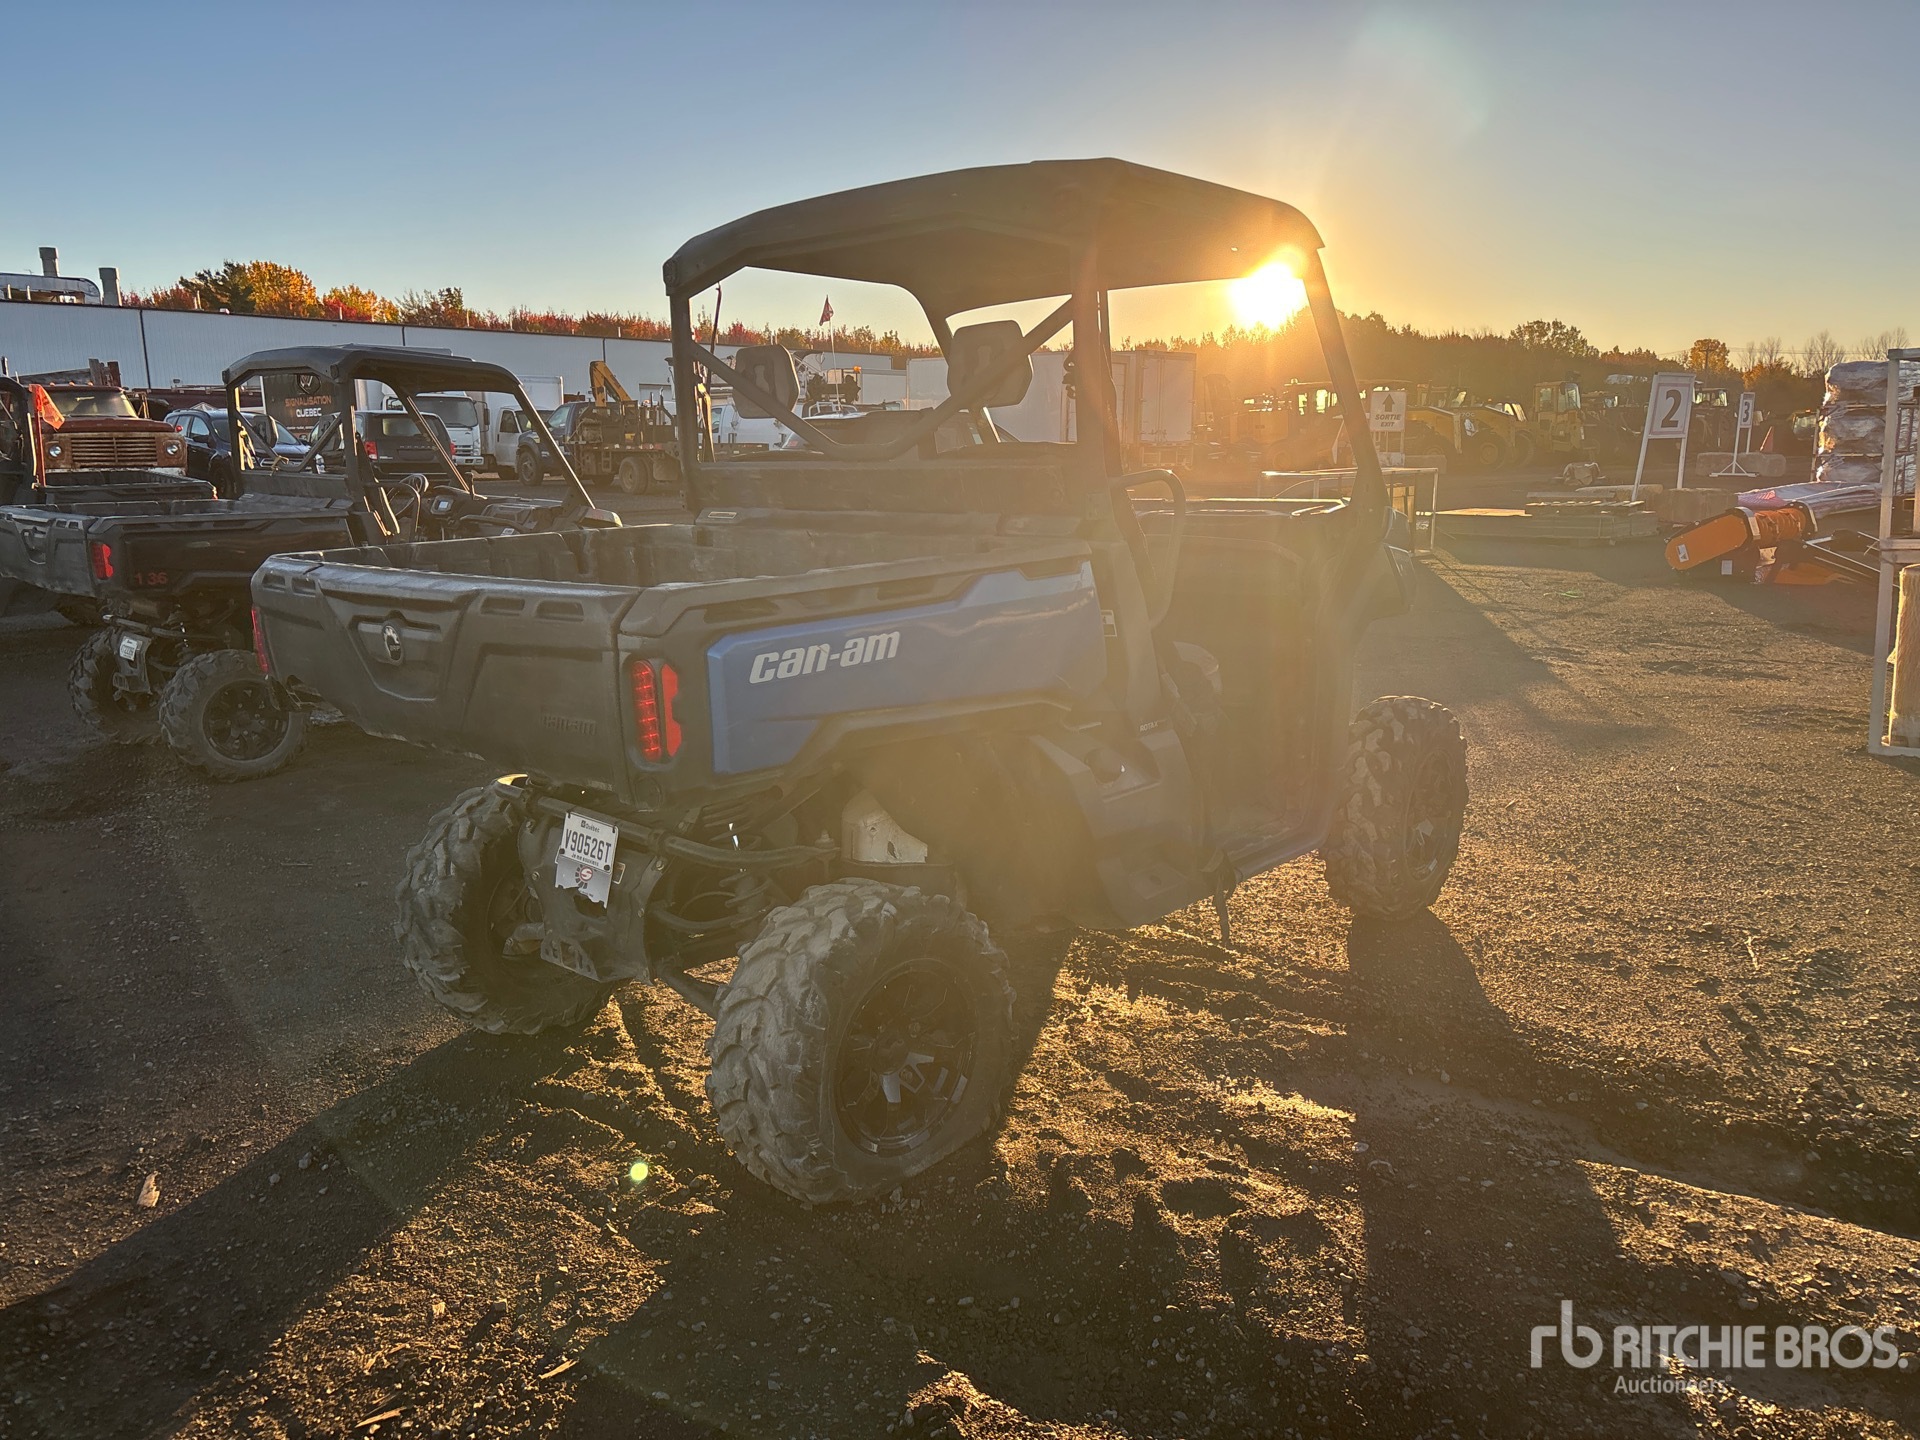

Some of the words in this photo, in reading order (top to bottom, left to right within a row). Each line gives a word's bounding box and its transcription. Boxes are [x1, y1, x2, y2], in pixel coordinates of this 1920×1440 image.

[285, 395, 332, 407] SIGNALISATION
[1661, 389, 1682, 428] 2
[296, 407, 322, 418] QUEBEC
[1375, 413, 1402, 421] SORTIE
[1743, 401, 1750, 423] 3
[749, 631, 900, 684] can-am
[1139, 720, 1159, 732] ROTAX
[565, 828, 612, 862] V90526T
